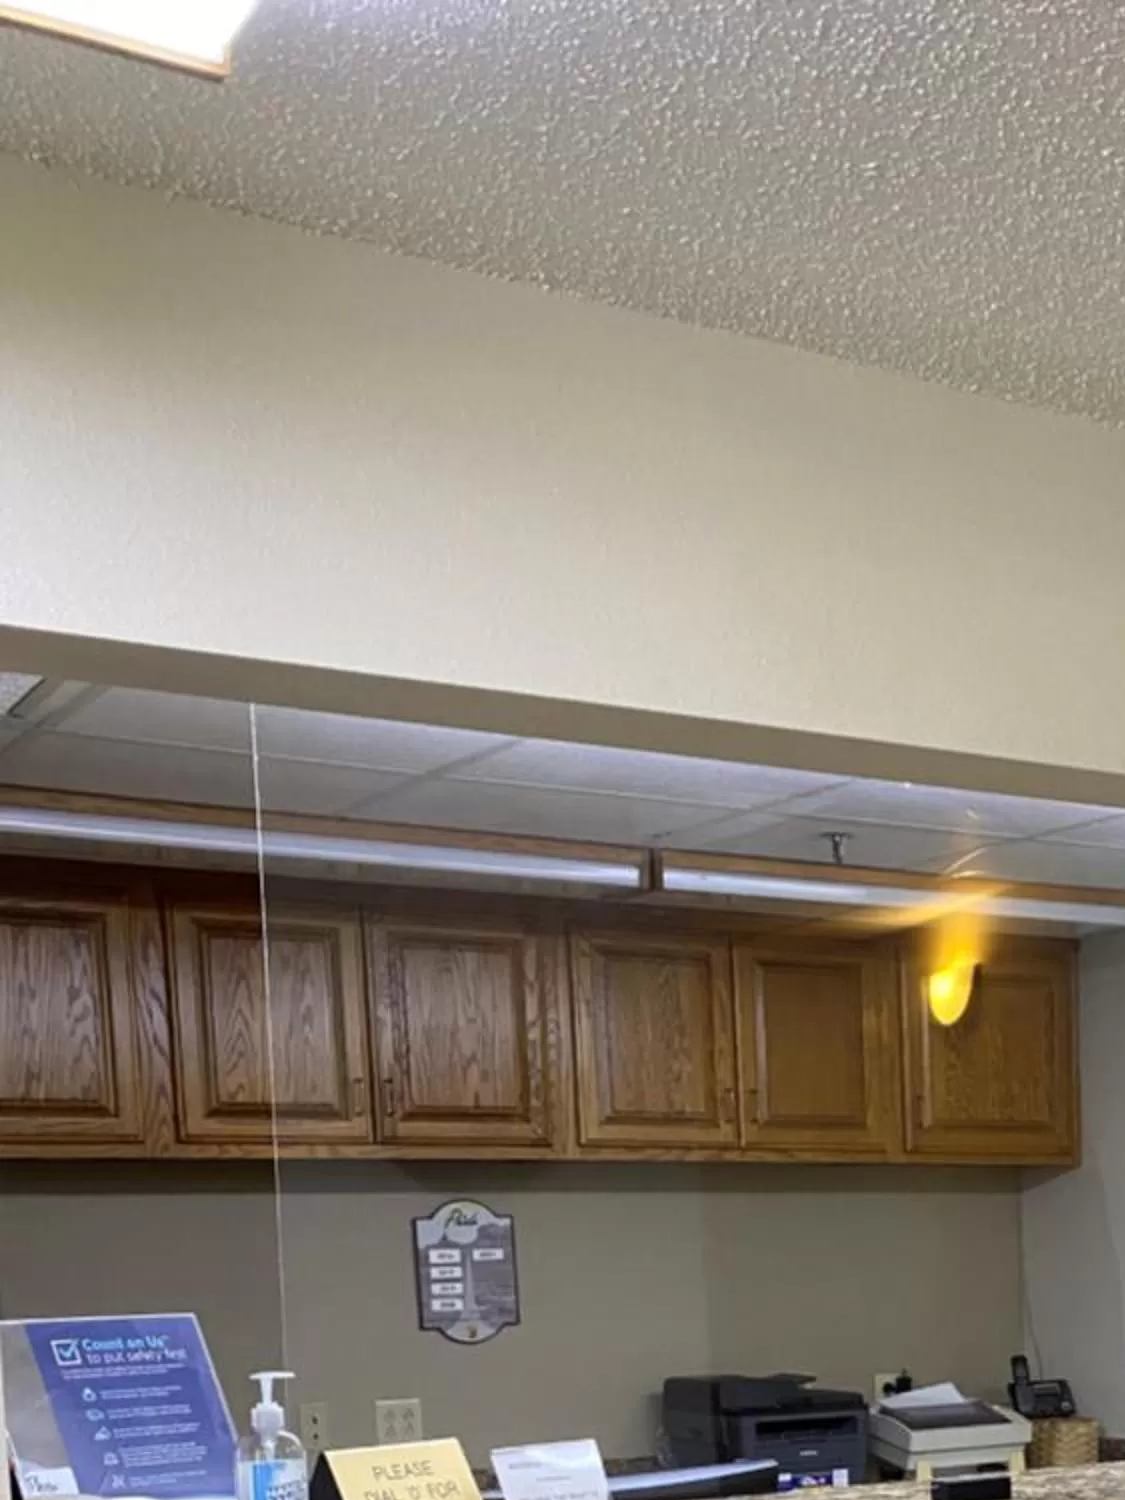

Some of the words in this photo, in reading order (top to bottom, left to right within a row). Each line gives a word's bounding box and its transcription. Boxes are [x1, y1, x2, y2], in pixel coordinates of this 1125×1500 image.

[82, 1337, 124, 1351] Count
[86, 1353, 102, 1365] to
[103, 1351, 126, 1364] put
[126, 1349, 162, 1363] safety
[371, 1460, 435, 1481] PLEASE
[426, 1480, 461, 1499] FOR
